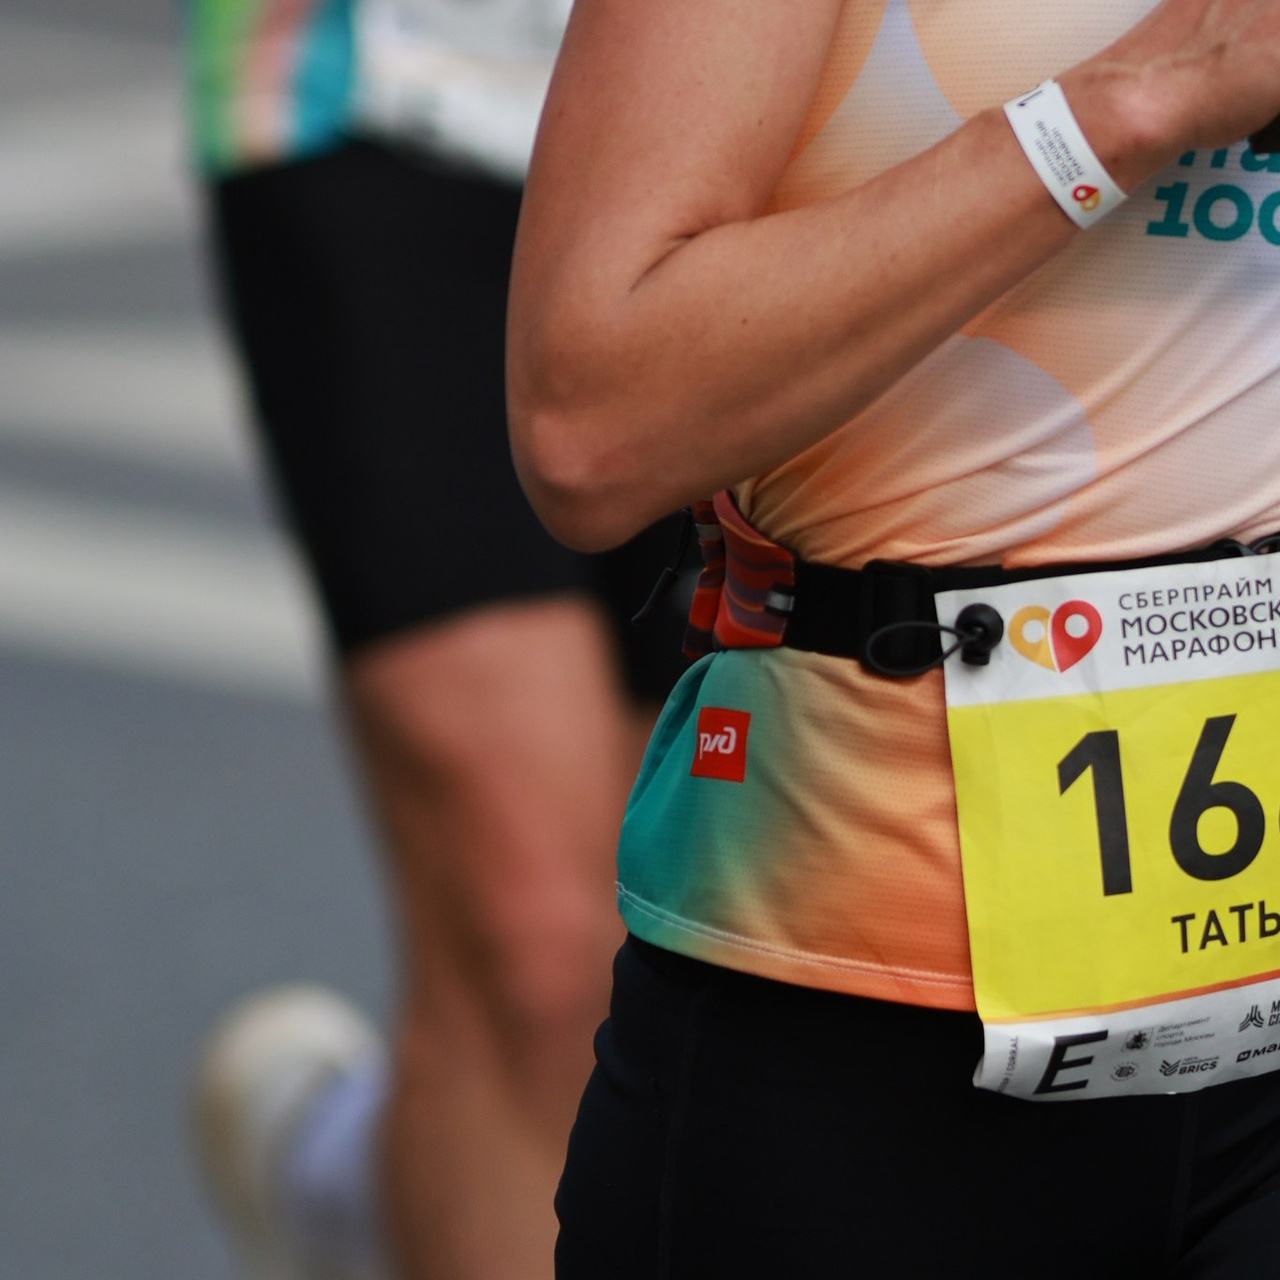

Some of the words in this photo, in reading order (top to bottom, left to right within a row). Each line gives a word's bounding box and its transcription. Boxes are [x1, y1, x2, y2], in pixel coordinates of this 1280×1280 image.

[1119, 577, 1273, 610] СБЕРПРАЙМ
[1123, 628, 1277, 666] МАРАФОН
[1032, 1029, 1109, 1095] E
[1178, 1060, 1218, 1075] BRICS
